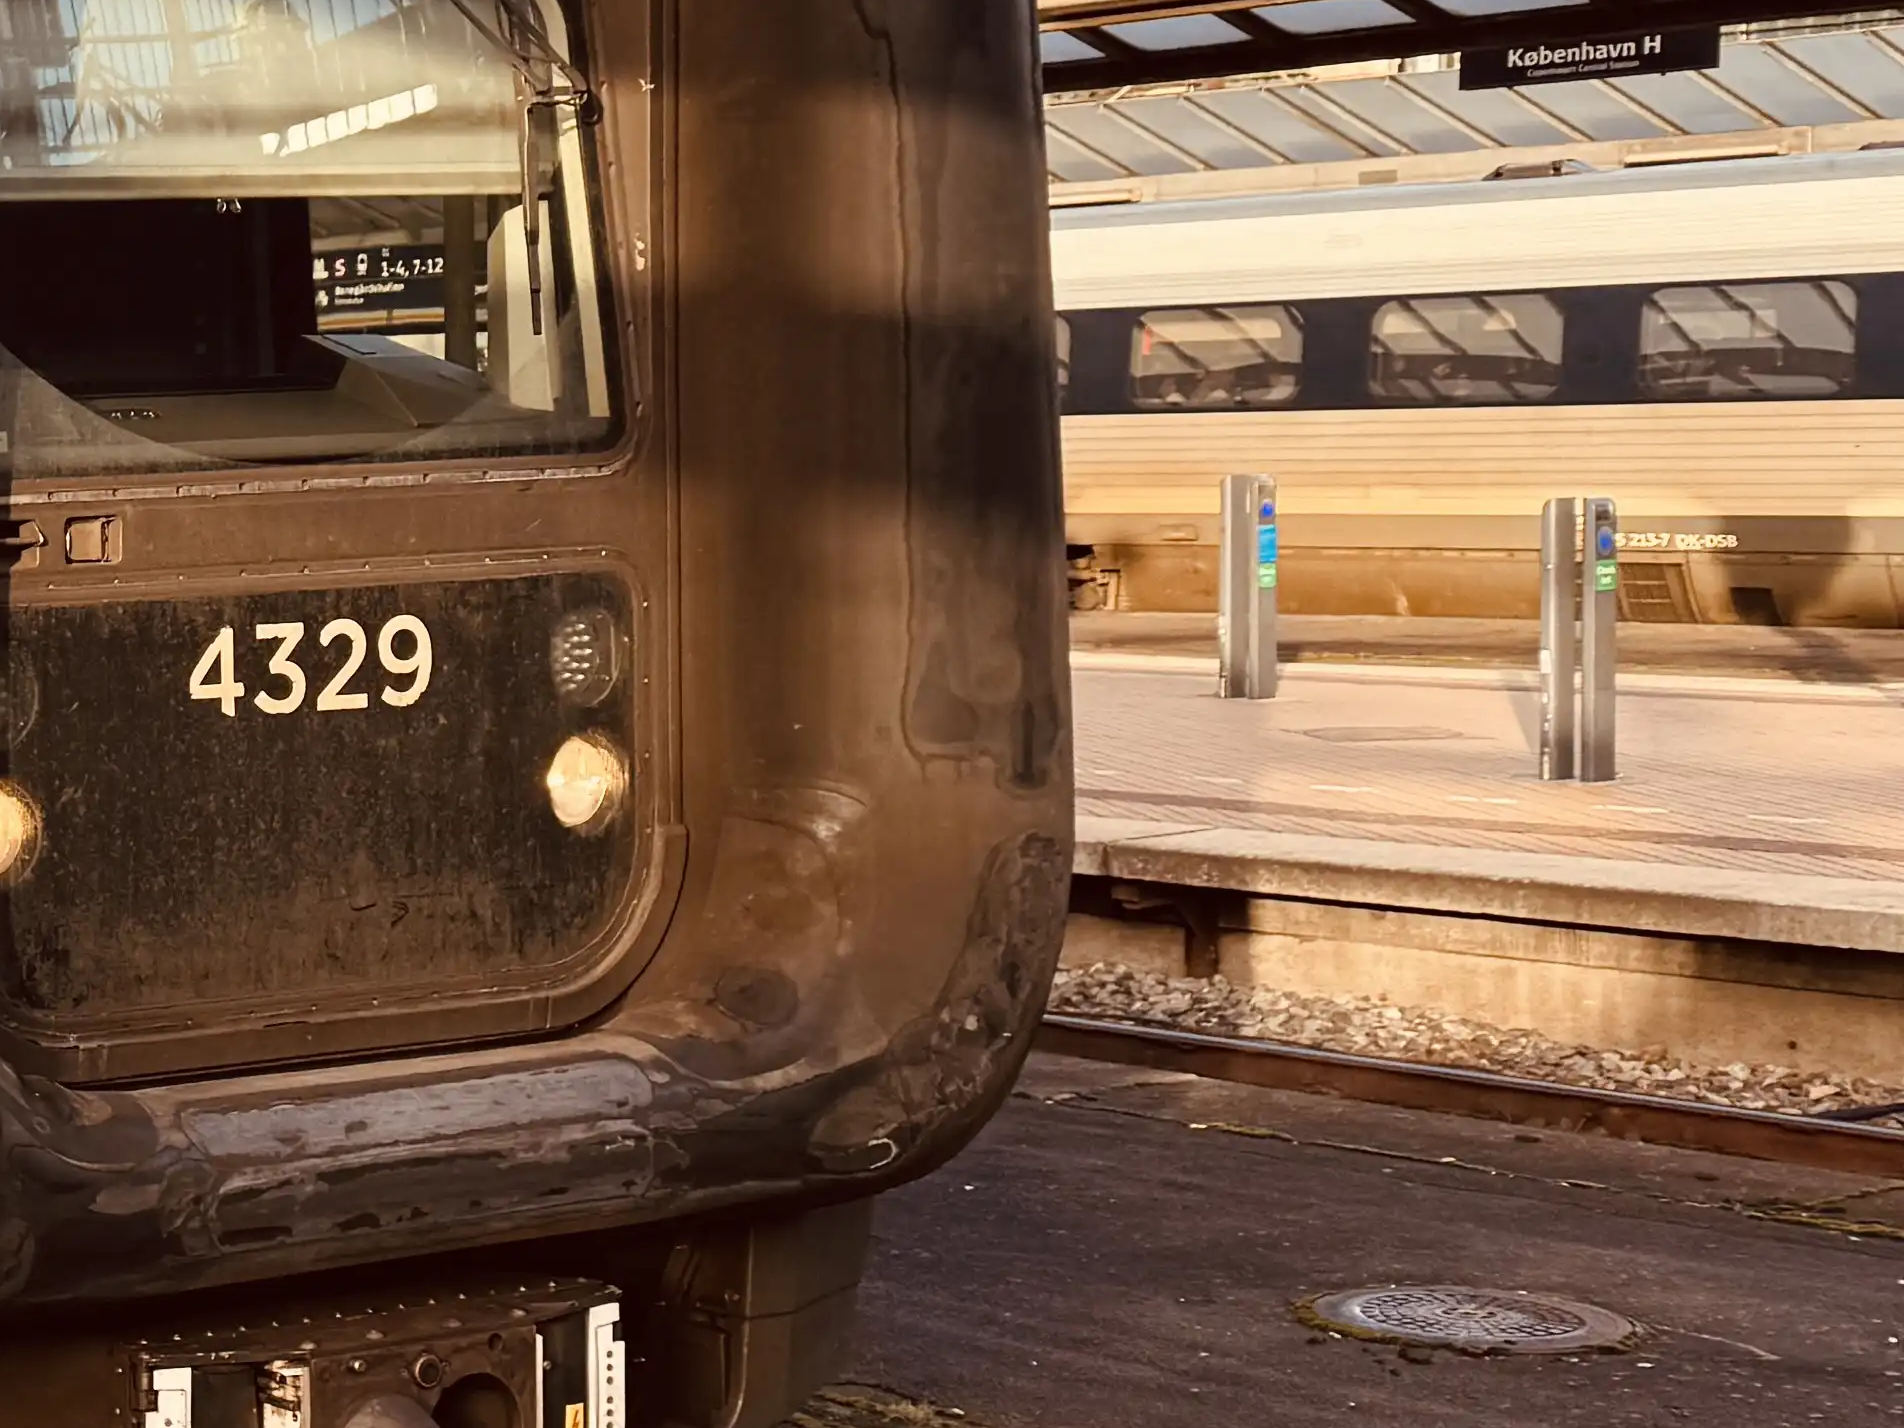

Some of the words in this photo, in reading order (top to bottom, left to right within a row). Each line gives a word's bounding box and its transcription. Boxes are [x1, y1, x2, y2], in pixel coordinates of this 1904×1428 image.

[1506, 41, 1637, 68] København
[1644, 34, 1662, 55] H
[189, 614, 434, 717] 4329
